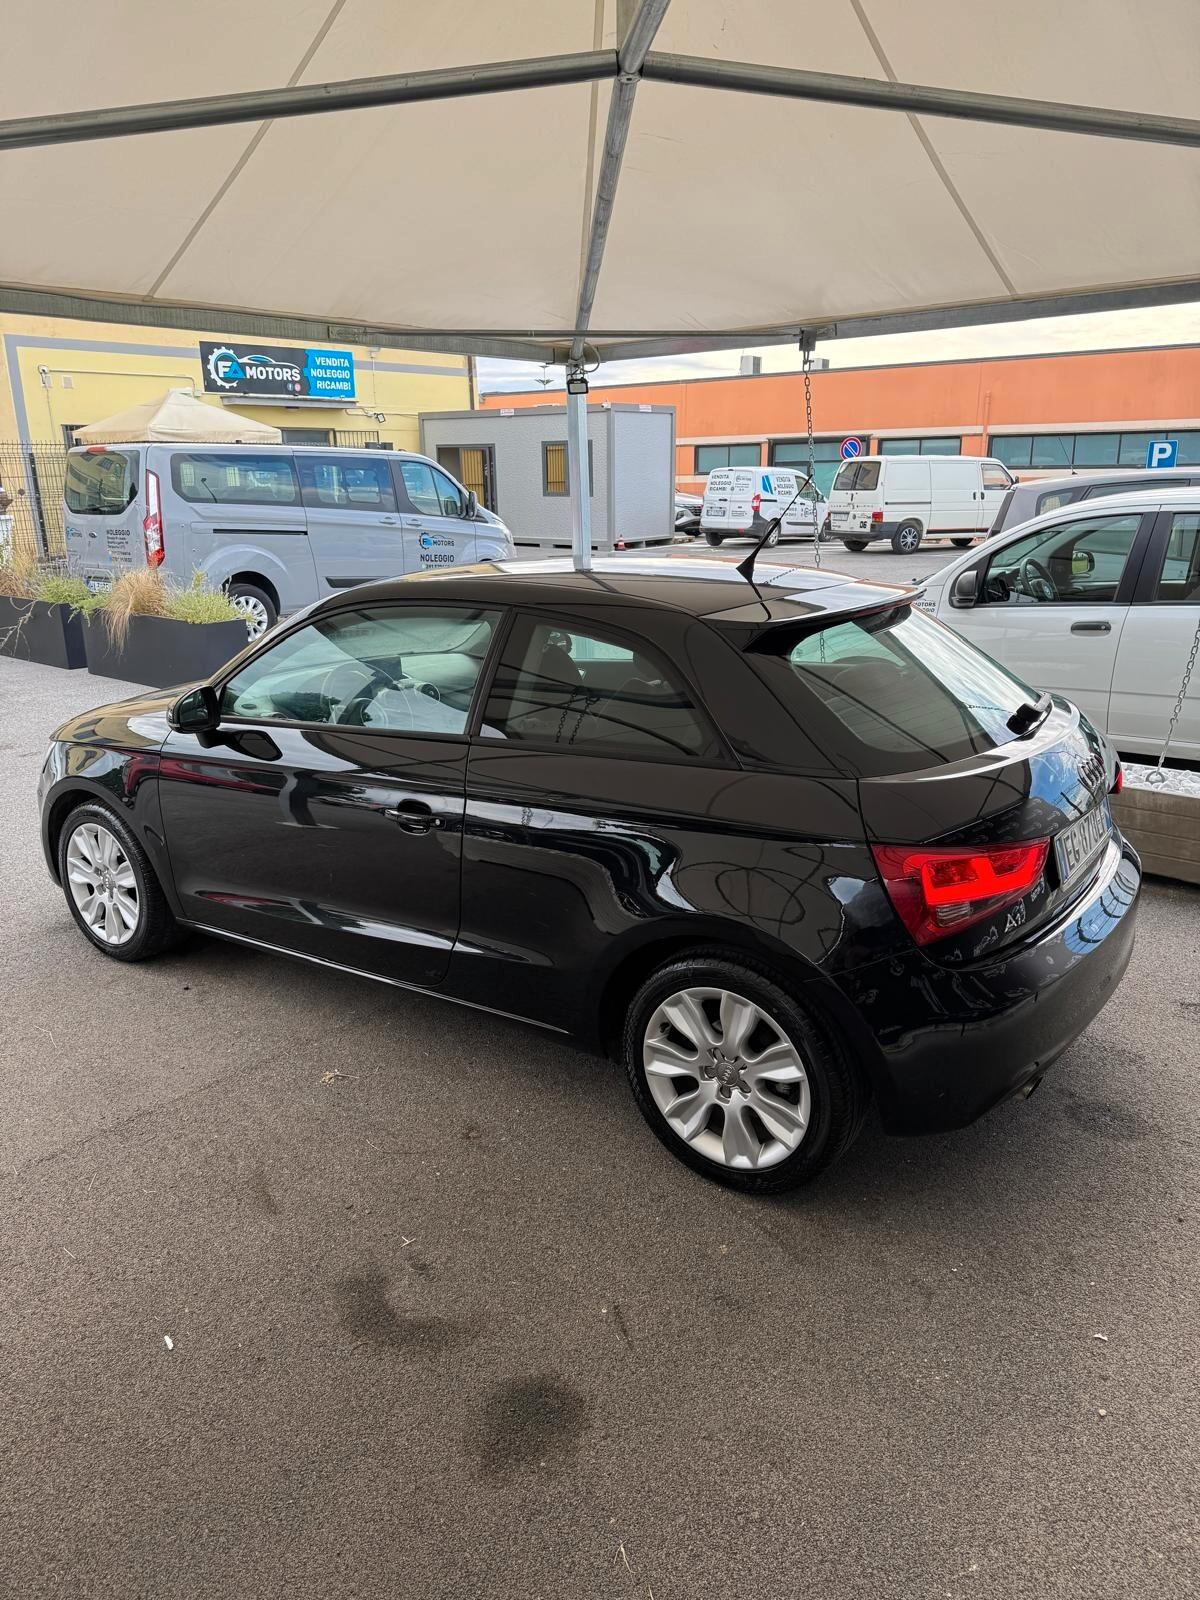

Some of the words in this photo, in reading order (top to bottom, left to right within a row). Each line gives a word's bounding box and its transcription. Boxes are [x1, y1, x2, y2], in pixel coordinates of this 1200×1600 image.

[314, 356, 350, 368] VENDITA
[246, 365, 301, 381] MOTORS
[310, 368, 351, 379] NOLEGGIO
[316, 380, 351, 391] RICAMBI
[1151, 443, 1172, 467] P
[420, 554, 455, 562] NOLEGGIO
[1064, 830, 1080, 869] EG
[1004, 913, 1021, 933] A1
